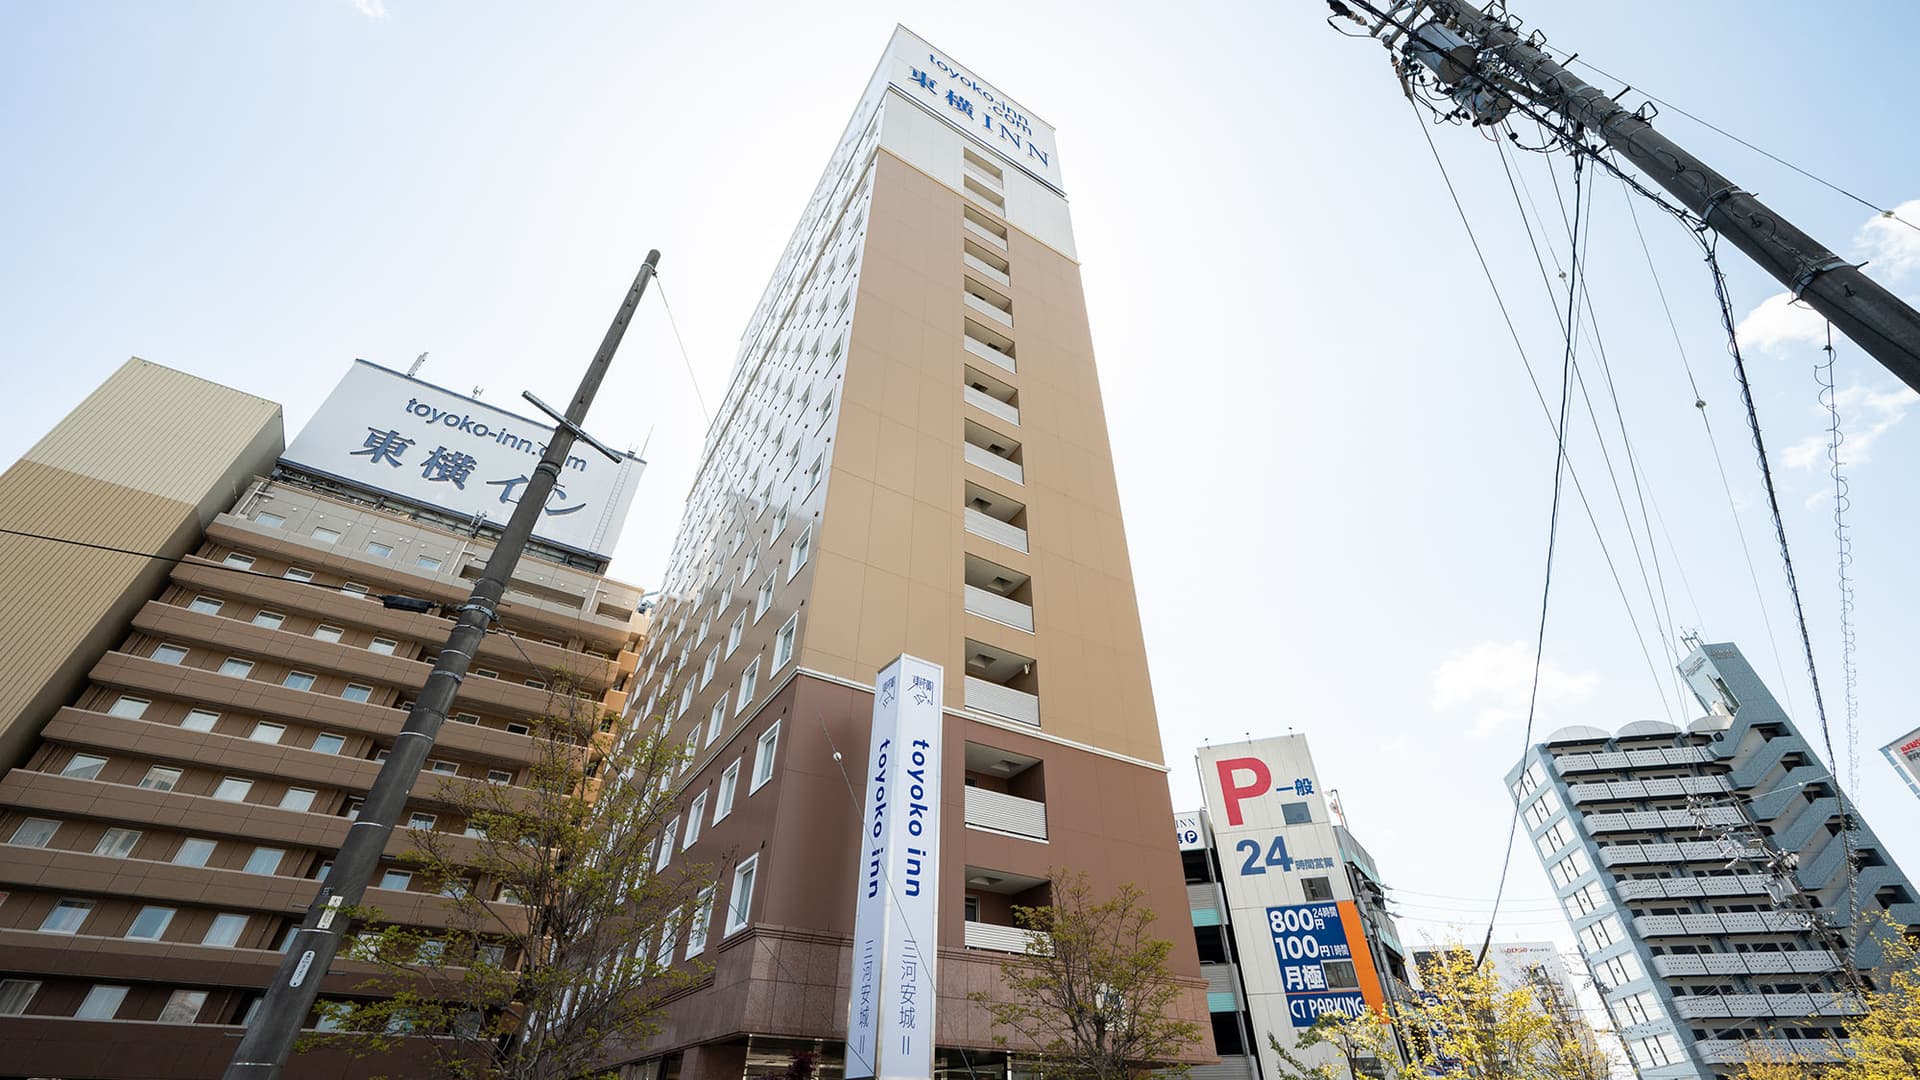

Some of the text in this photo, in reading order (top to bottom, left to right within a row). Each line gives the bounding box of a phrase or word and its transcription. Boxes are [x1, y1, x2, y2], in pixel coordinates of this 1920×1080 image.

[868, 738, 891, 899] toyoko inn
[905, 739, 930, 897] toyoko inn
[1216, 757, 1314, 826] P 一般
[1285, 965, 1325, 990] 月極
[1290, 996, 1366, 1019] CT PARKING
